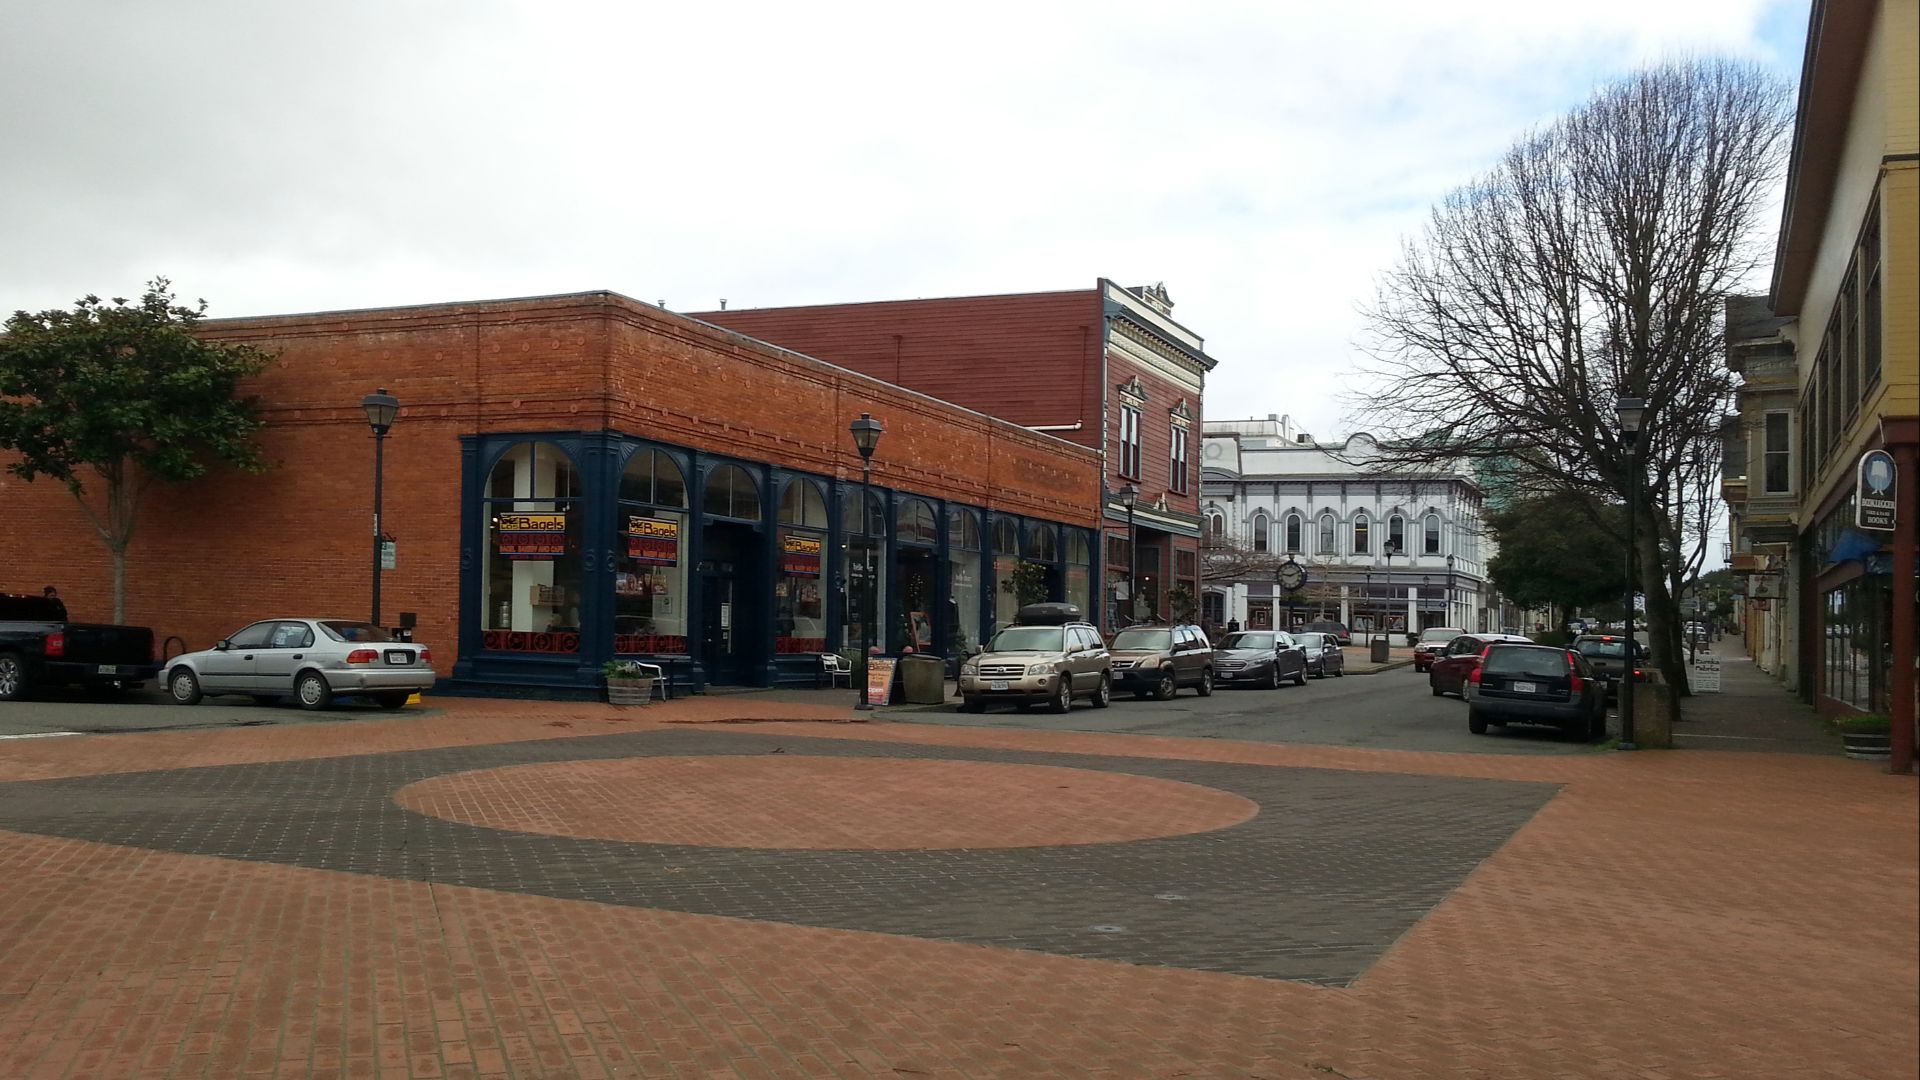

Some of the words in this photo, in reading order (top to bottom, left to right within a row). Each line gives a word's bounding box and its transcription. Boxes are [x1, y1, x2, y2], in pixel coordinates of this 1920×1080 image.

[519, 516, 564, 531] Bagels
[1867, 516, 1888, 524] BOOKS
[644, 522, 677, 537] Bagels
